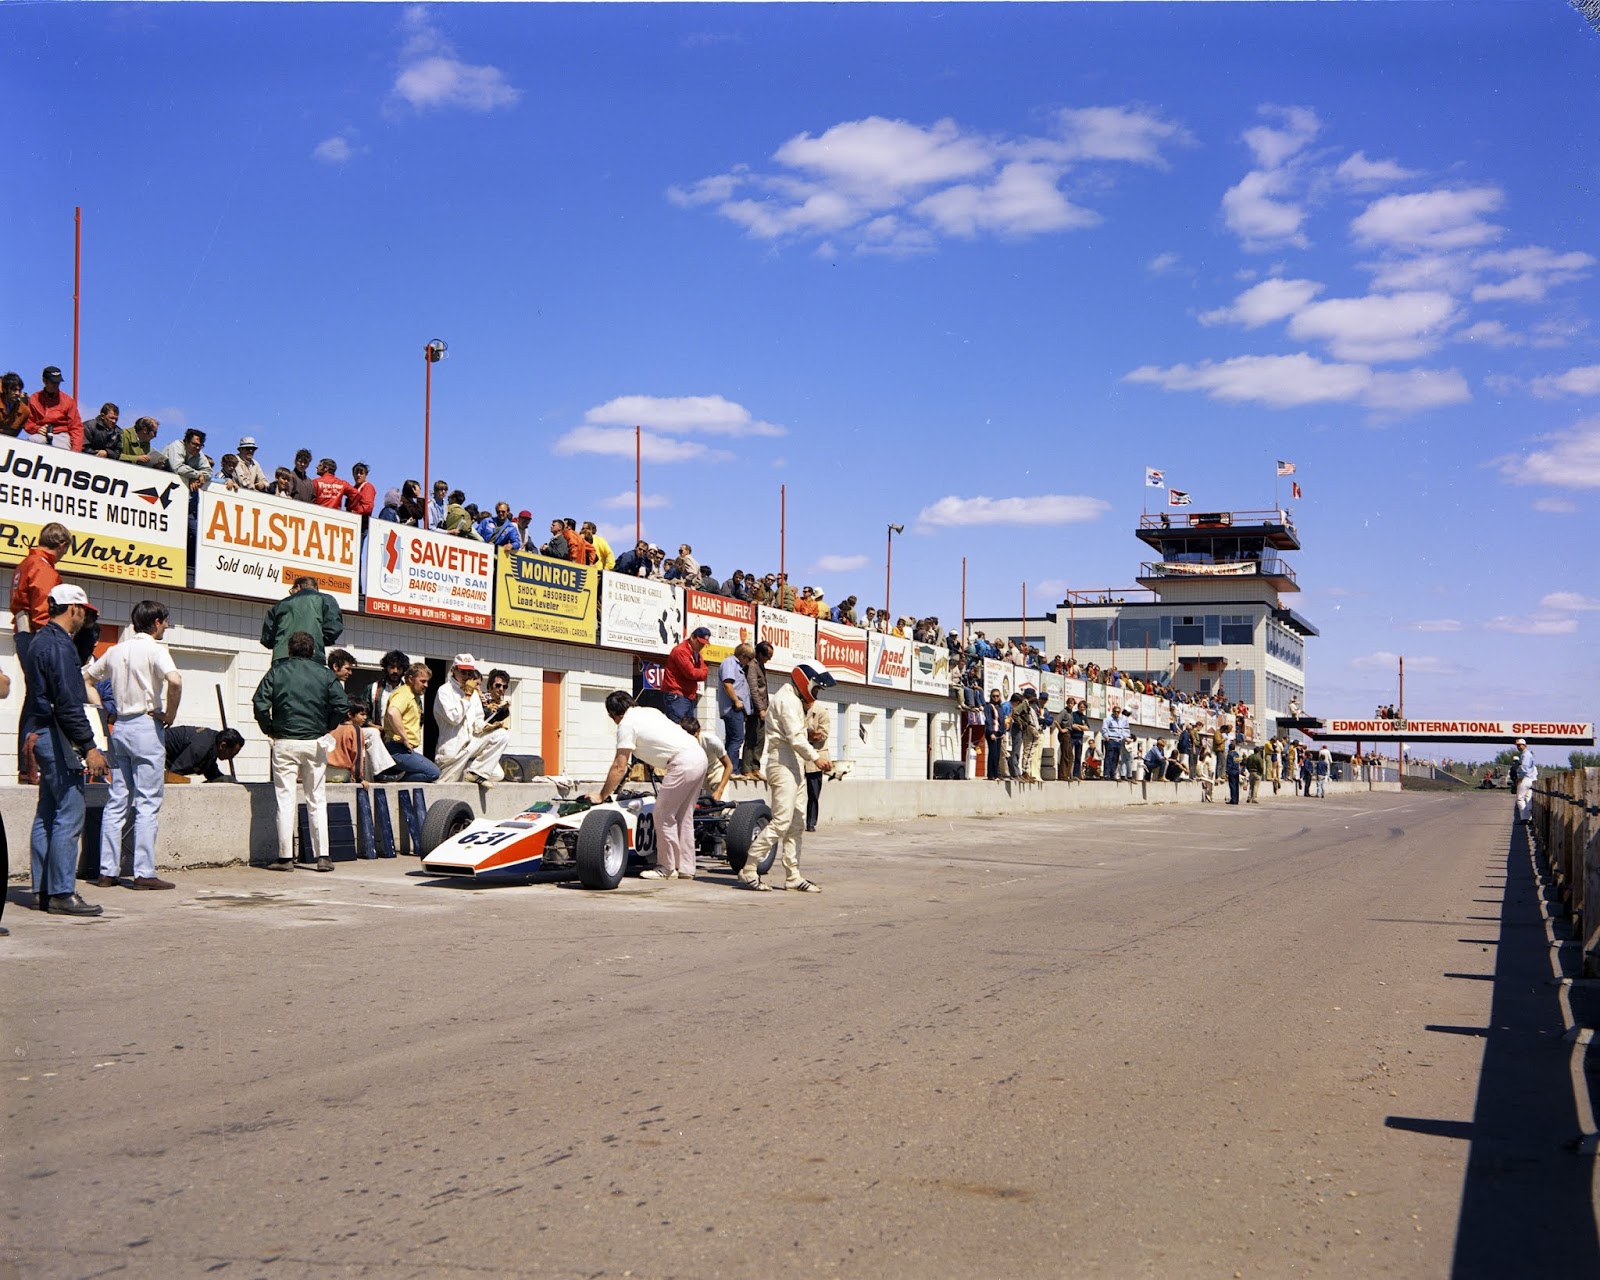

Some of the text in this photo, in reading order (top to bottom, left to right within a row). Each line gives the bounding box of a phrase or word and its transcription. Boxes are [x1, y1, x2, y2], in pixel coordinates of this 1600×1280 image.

[0, 449, 129, 498] Johnson
[0, 483, 168, 532] SEA-HORSE MOTORS
[206, 500, 354, 565] ALLSTATE
[70, 534, 172, 571] Marine
[410, 538, 488, 576] SAVETTE
[100, 563, 157, 580] 455-2135
[216, 555, 350, 590] Sold only by Sins-Sears
[409, 567, 487, 590] DISCOUNT SAM
[521, 561, 577, 588] MONROE
[409, 578, 437, 593] BANGS
[451, 585, 488, 602] BARGAINS
[518, 585, 578, 604] SHOCK ABSORBERS
[615, 581, 663, 599] CHEVALIER GRILL
[615, 592, 622, 601] LA
[373, 601, 390, 612] OPEN
[422, 608, 434, 618] MON
[475, 616, 486, 626] SAT
[572, 628, 588, 637] CARSON
[761, 624, 789, 648] SOUTH
[820, 638, 864, 665] Firestone
[882, 646, 905, 664] Road
[878, 660, 910, 678] Runner
[1332, 721, 1587, 735] EDMONTON INTERNATIONAL SPEEDWAY
[458, 831, 517, 846] 631
